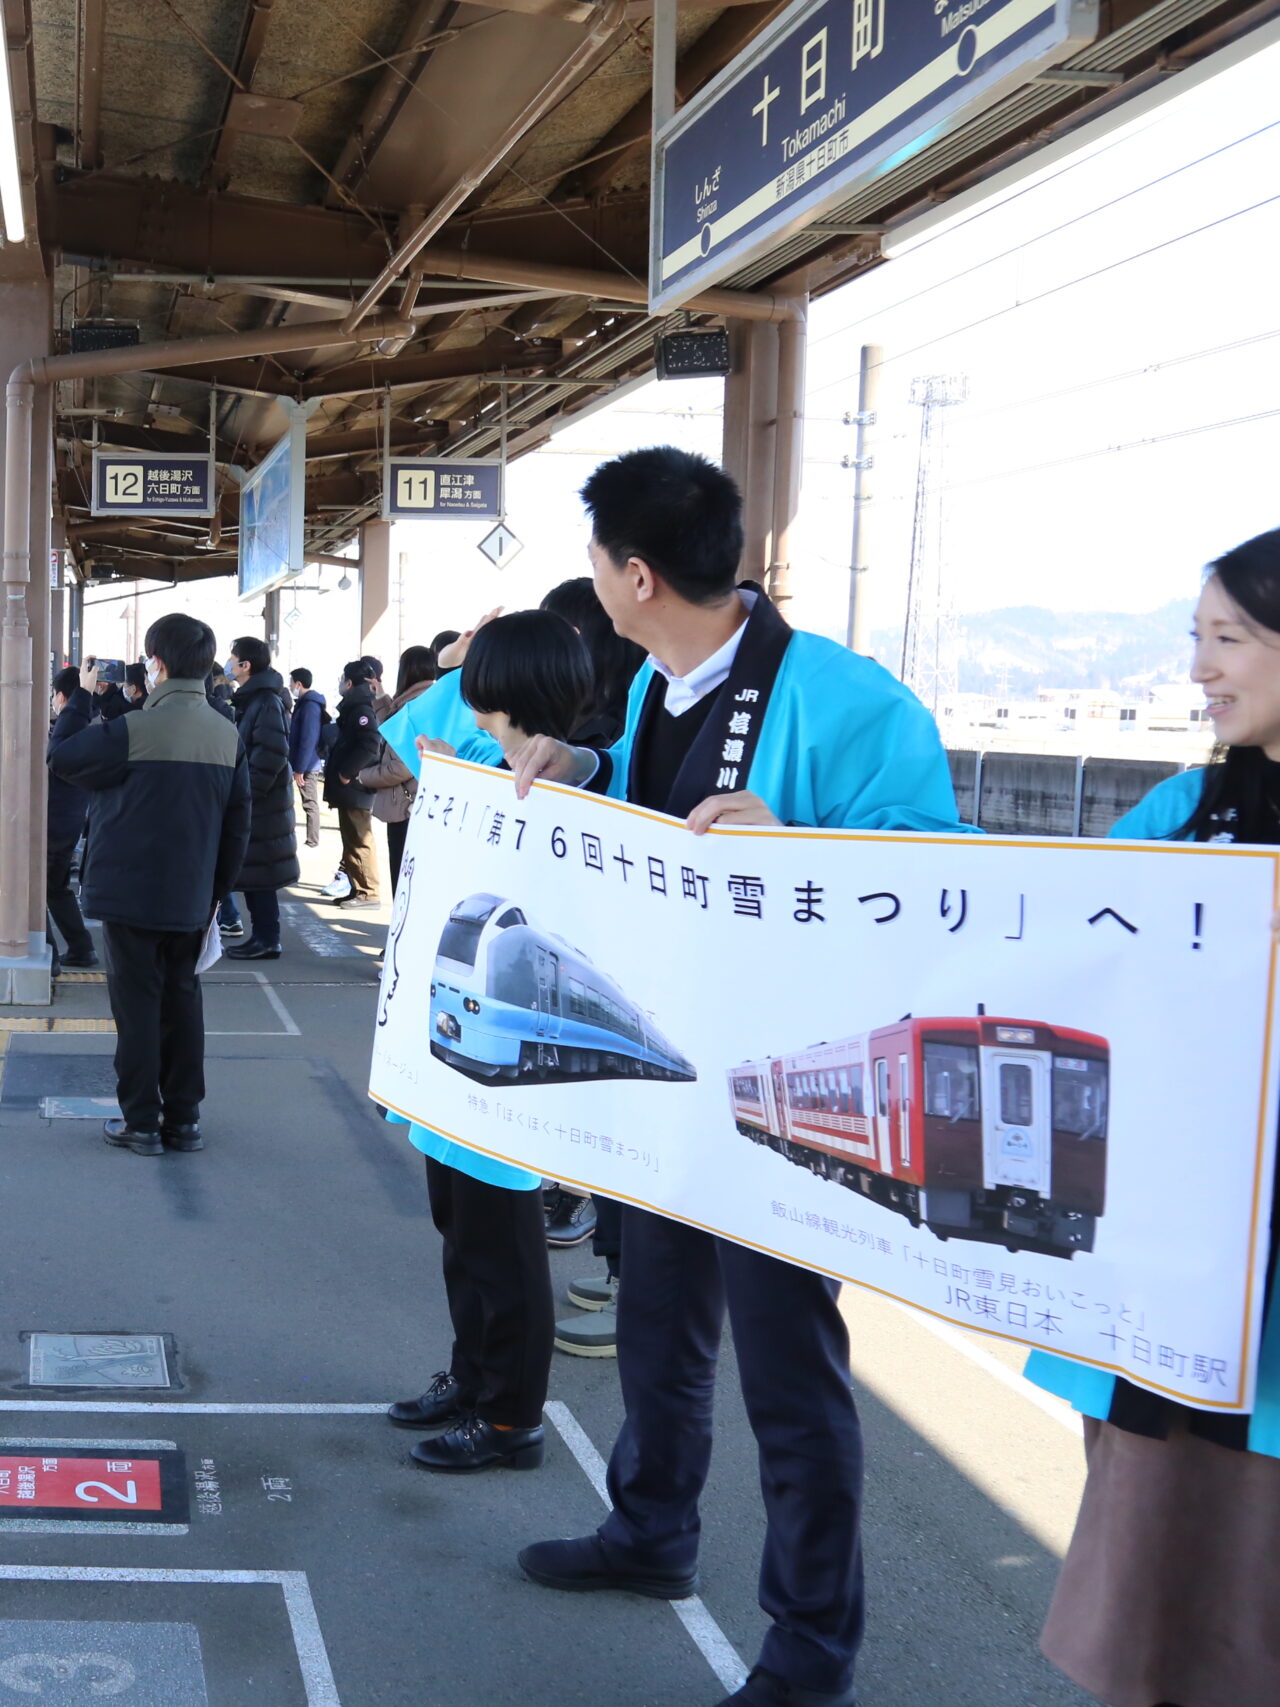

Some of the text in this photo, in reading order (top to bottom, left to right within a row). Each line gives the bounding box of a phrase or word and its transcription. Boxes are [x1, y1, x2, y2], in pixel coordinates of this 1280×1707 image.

[752, 0, 886, 147] 十日町
[781, 93, 846, 162] Tokamachi
[775, 129, 849, 199] 新潟県十日町市
[695, 165, 722, 205] しんざ
[697, 200, 718, 223] Shinza
[109, 472, 139, 496] 12
[147, 469, 193, 481] 越後湯沢
[440, 474, 474, 486] 直江津
[147, 483, 200, 495] 六日町 方面
[403, 477, 428, 500] 11
[440, 487, 481, 499] 犀潟 方面
[945, 1285, 1228, 1388] JR東日本 十日町駅
